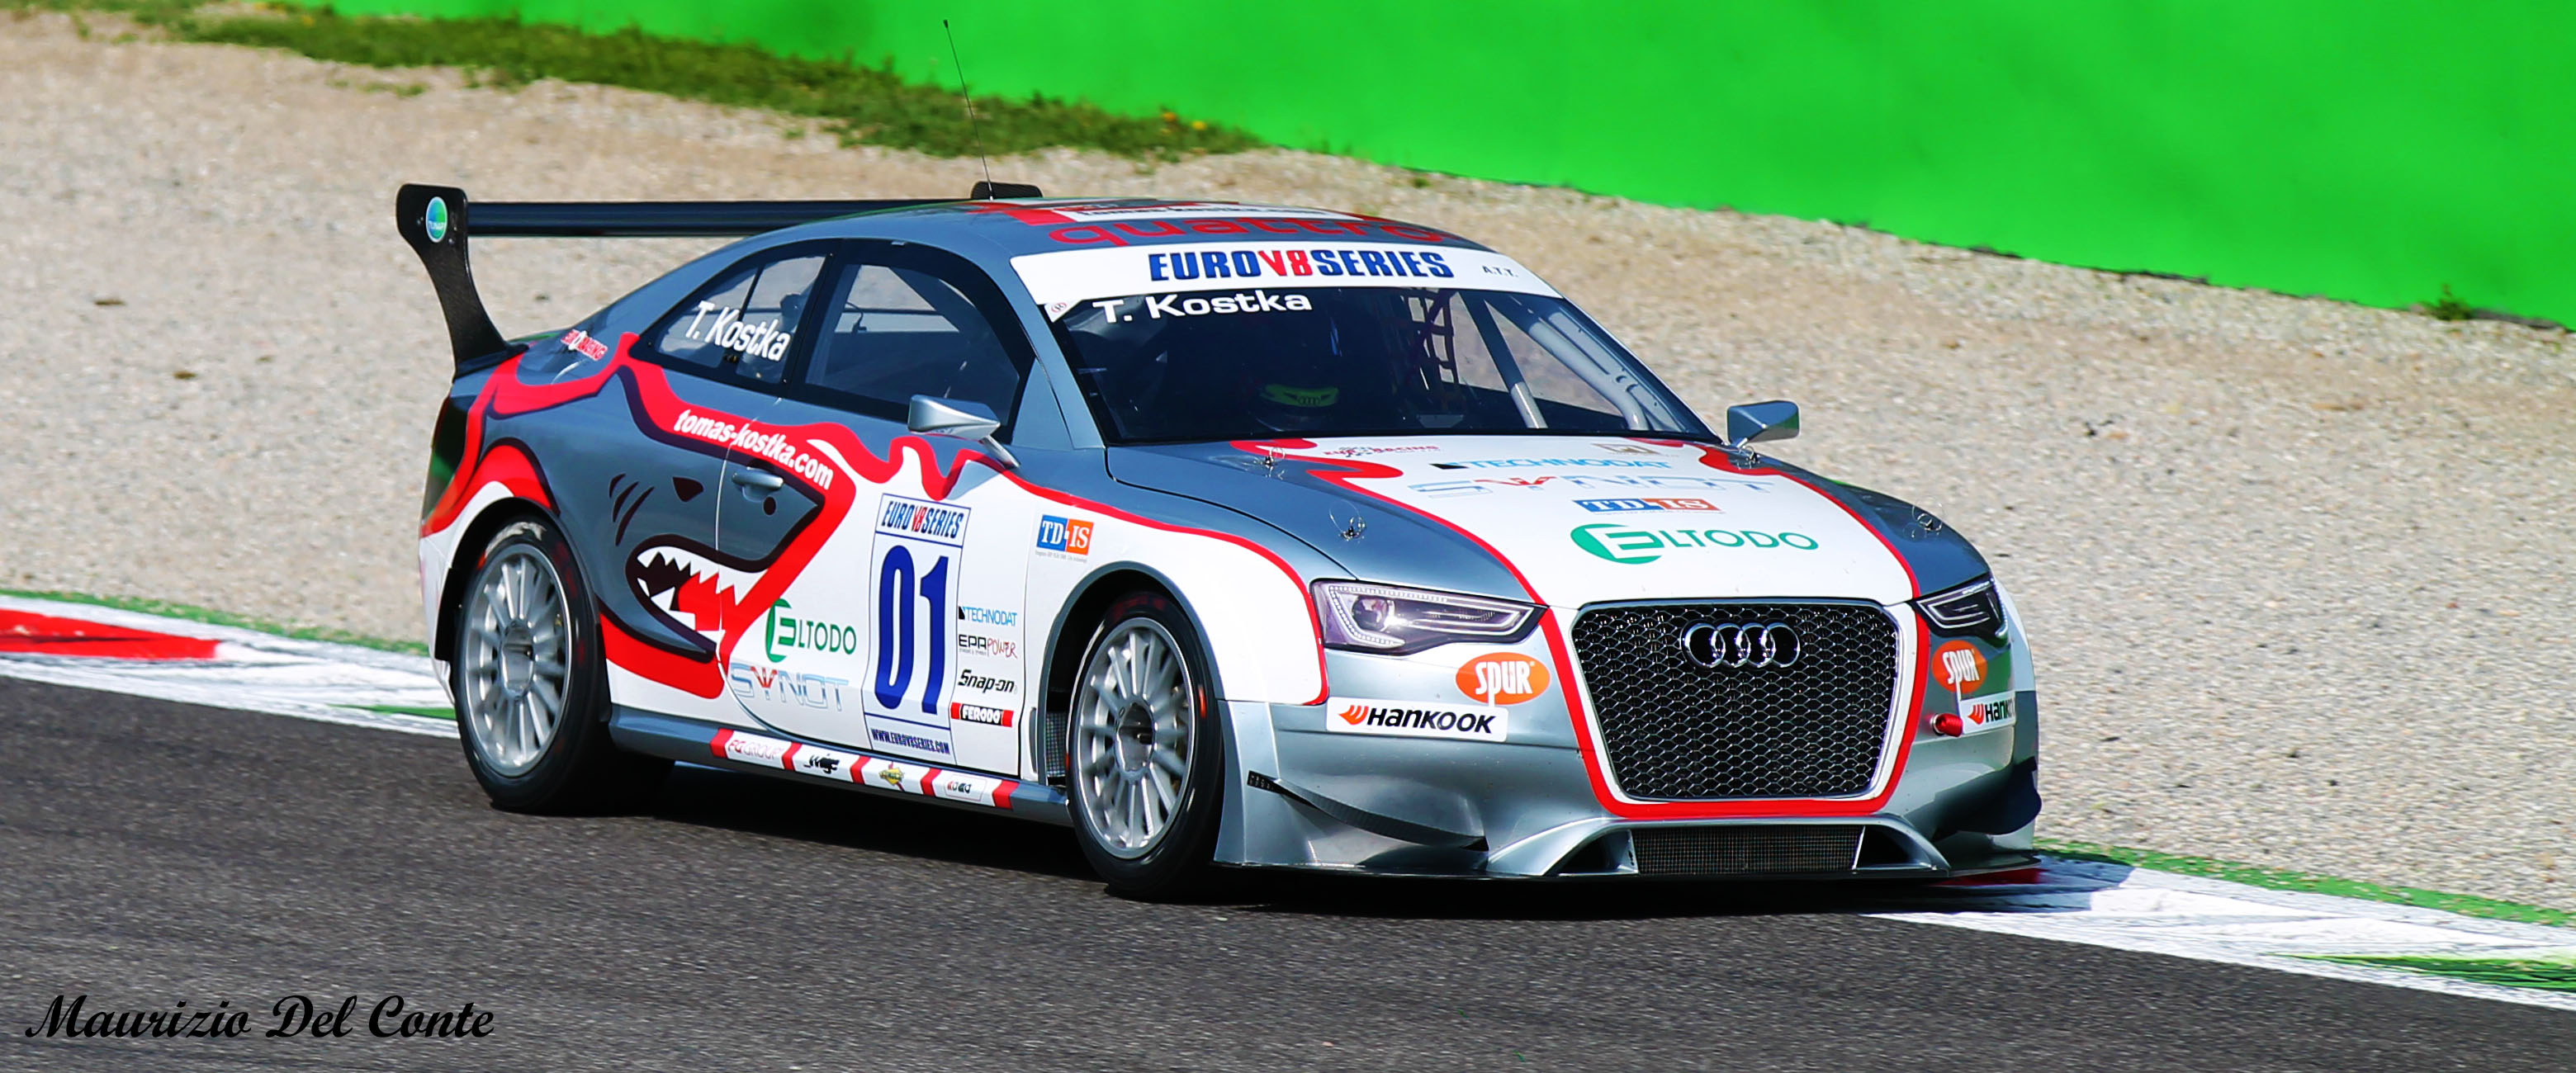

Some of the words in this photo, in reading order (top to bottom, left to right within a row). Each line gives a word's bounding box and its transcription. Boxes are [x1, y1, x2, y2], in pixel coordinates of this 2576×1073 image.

[1049, 216, 1443, 246] quattro
[1149, 249, 1454, 281] EUROV8SERIES
[1092, 299, 1133, 324] T.
[1145, 290, 1313, 319] Kostka
[685, 300, 715, 340] T.
[704, 306, 791, 362] Kostka
[673, 409, 834, 490] tomas-kostka.com
[1463, 458, 1674, 470] TECHNODAT
[1409, 475, 1778, 499] SYNOT
[1570, 523, 1819, 565] ELTODO
[765, 598, 856, 663] ELTODO
[874, 545, 949, 715] 01
[963, 605, 1018, 626] TECHNODAT
[730, 662, 849, 711] SYNOT
[958, 669, 1015, 693] Snap-on
[962, 704, 1002, 724] FERODO
